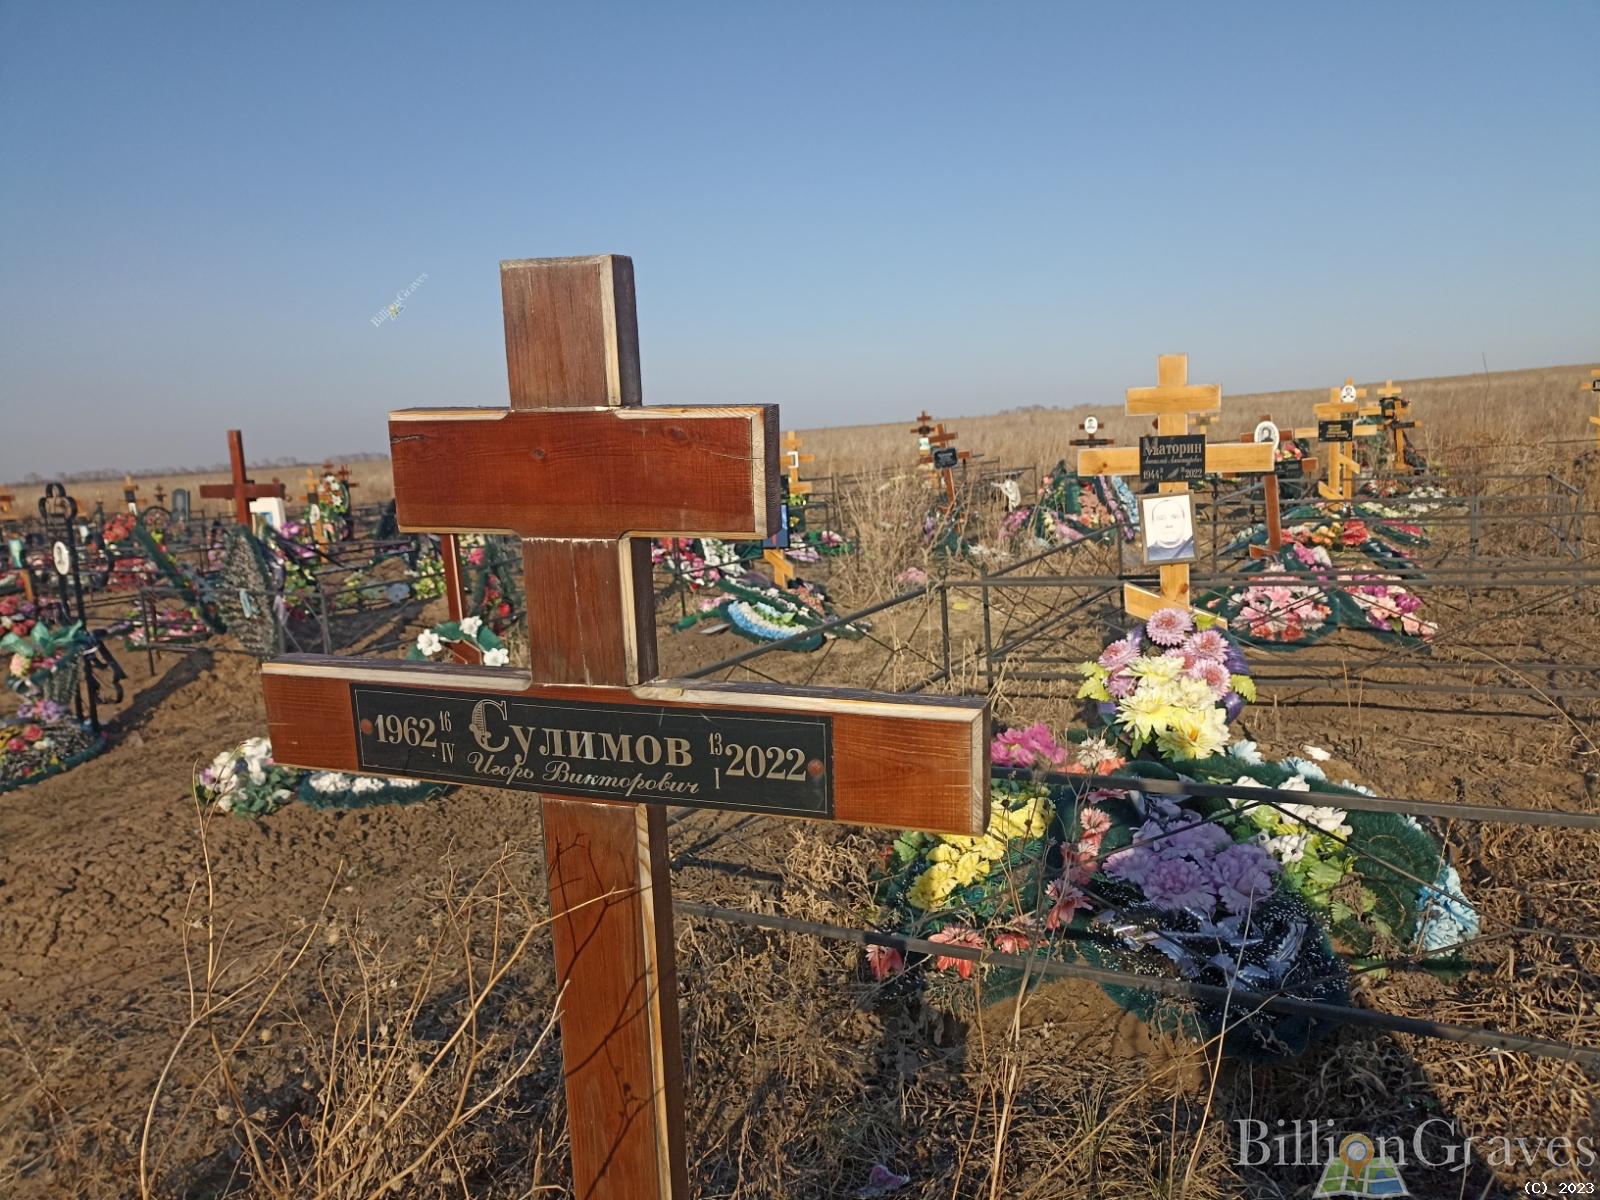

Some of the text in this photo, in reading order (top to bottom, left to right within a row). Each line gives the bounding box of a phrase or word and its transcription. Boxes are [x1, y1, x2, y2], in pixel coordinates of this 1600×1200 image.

[1143, 437, 1202, 458] Маторин
[1185, 468, 1203, 478] 2022
[374, 714, 438, 749] 1962
[439, 710, 452, 733] 16
[469, 698, 694, 767] Сулимов
[441, 742, 456, 764] IV
[708, 732, 723, 755] 13
[725, 743, 806, 782] 2022
[467, 752, 700, 797] Игорь Викторович
